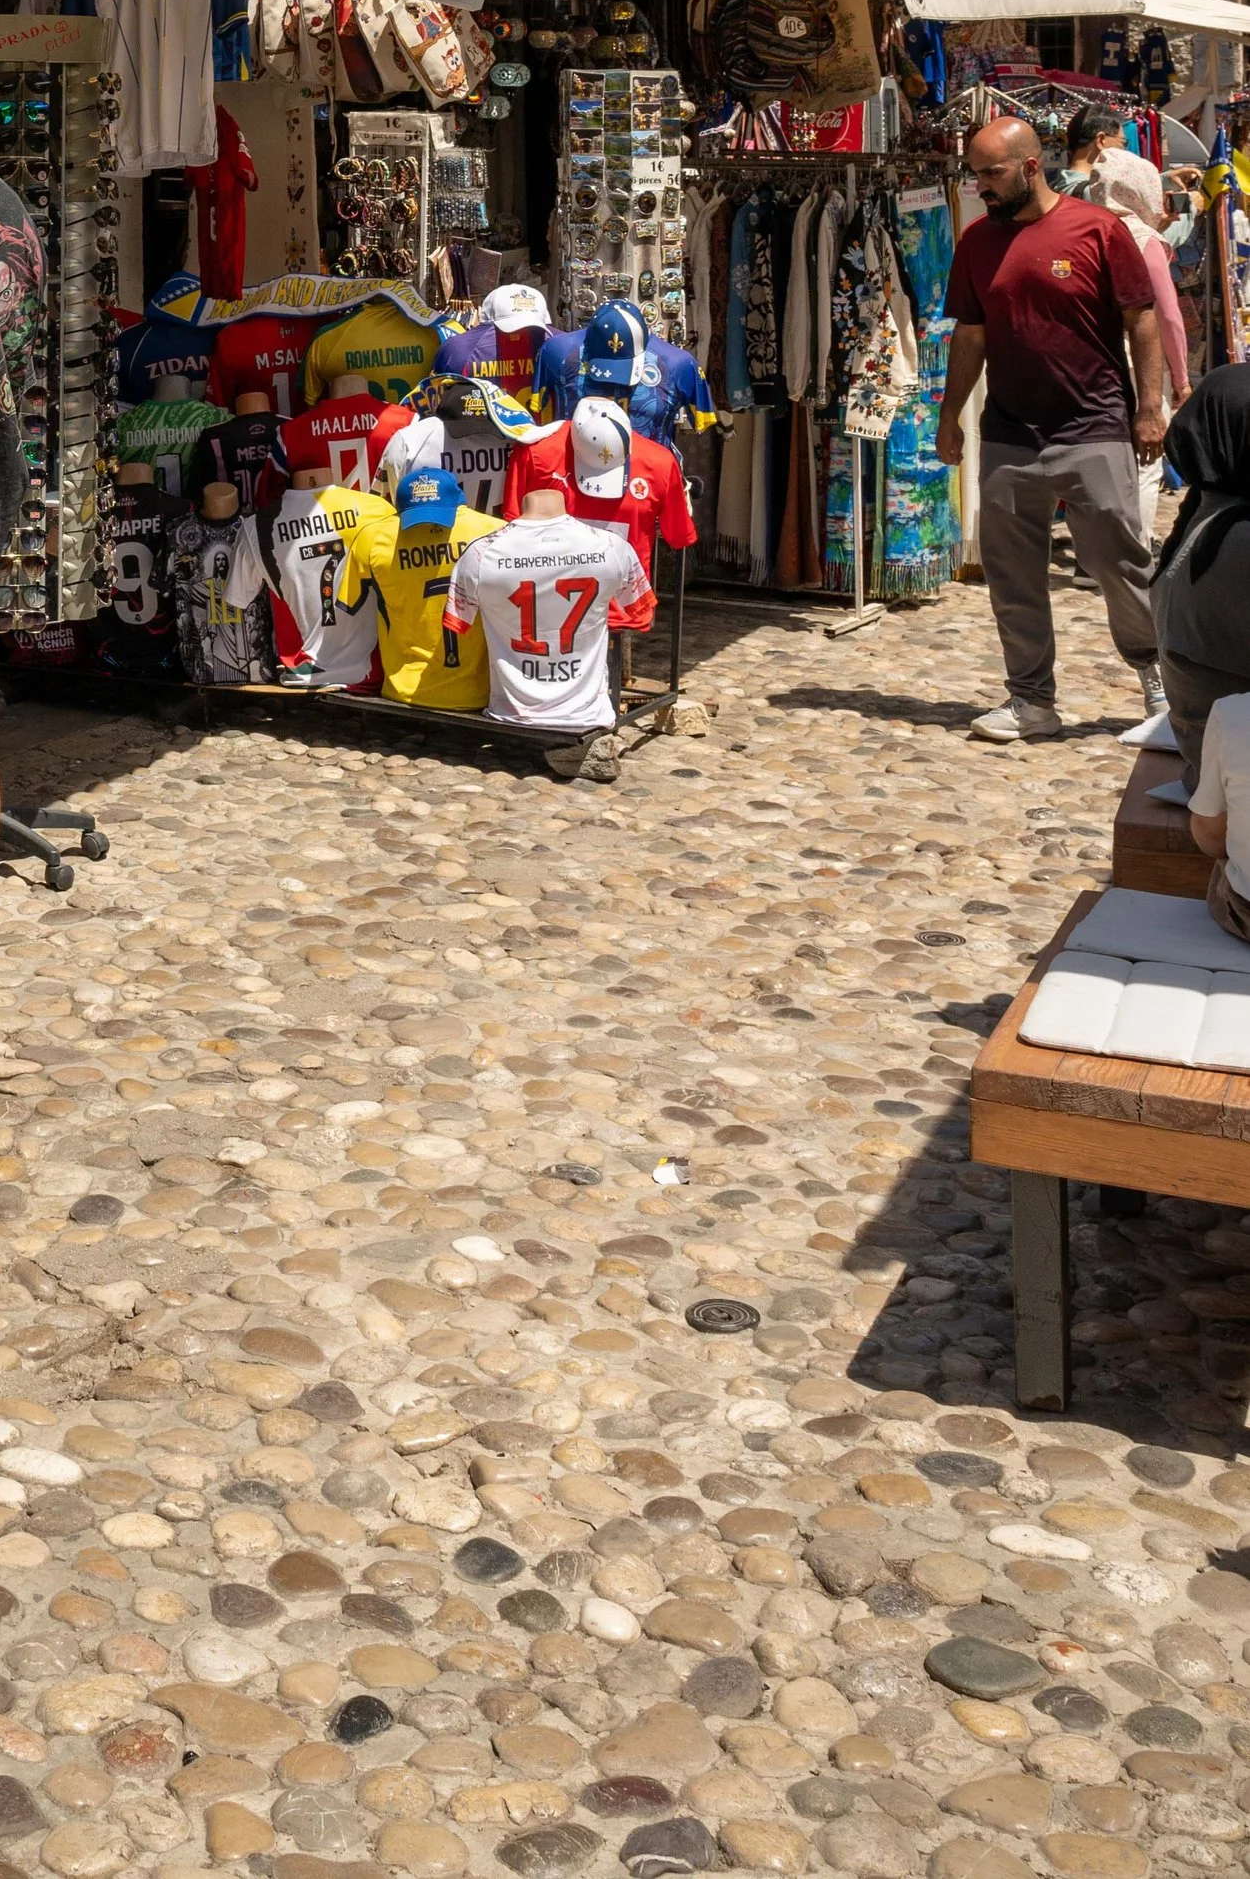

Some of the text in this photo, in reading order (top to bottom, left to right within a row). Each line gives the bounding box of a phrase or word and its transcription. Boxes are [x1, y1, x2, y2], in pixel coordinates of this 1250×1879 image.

[784, 19, 805, 34] 10€
[45, 29, 82, 52] GUCCI
[384, 117, 401, 128] 1€
[816, 110, 845, 129] Cola
[404, 130, 423, 142] 5€
[650, 161, 665, 172] 1€
[638, 178, 662, 186] pieces
[667, 173, 681, 186] 5€
[273, 276, 316, 308] AND
[144, 355, 211, 380] ZIDAN
[255, 347, 302, 370] M.SAL
[345, 345, 424, 370] RONALDINHO
[472, 357, 534, 378] LAMINE YA
[311, 413, 379, 437] HAALAND
[236, 443, 272, 463] MES
[277, 509, 357, 543] RONALDO
[302, 546, 314, 559] CR
[398, 541, 468, 571] RONALD
[498, 552, 606, 570] FC BAYERN MÜNCHEN
[113, 541, 159, 625] 9
[507, 576, 599, 657] 17
[37, 637, 76, 650] ACNUR
[521, 659, 582, 683] OLISE
